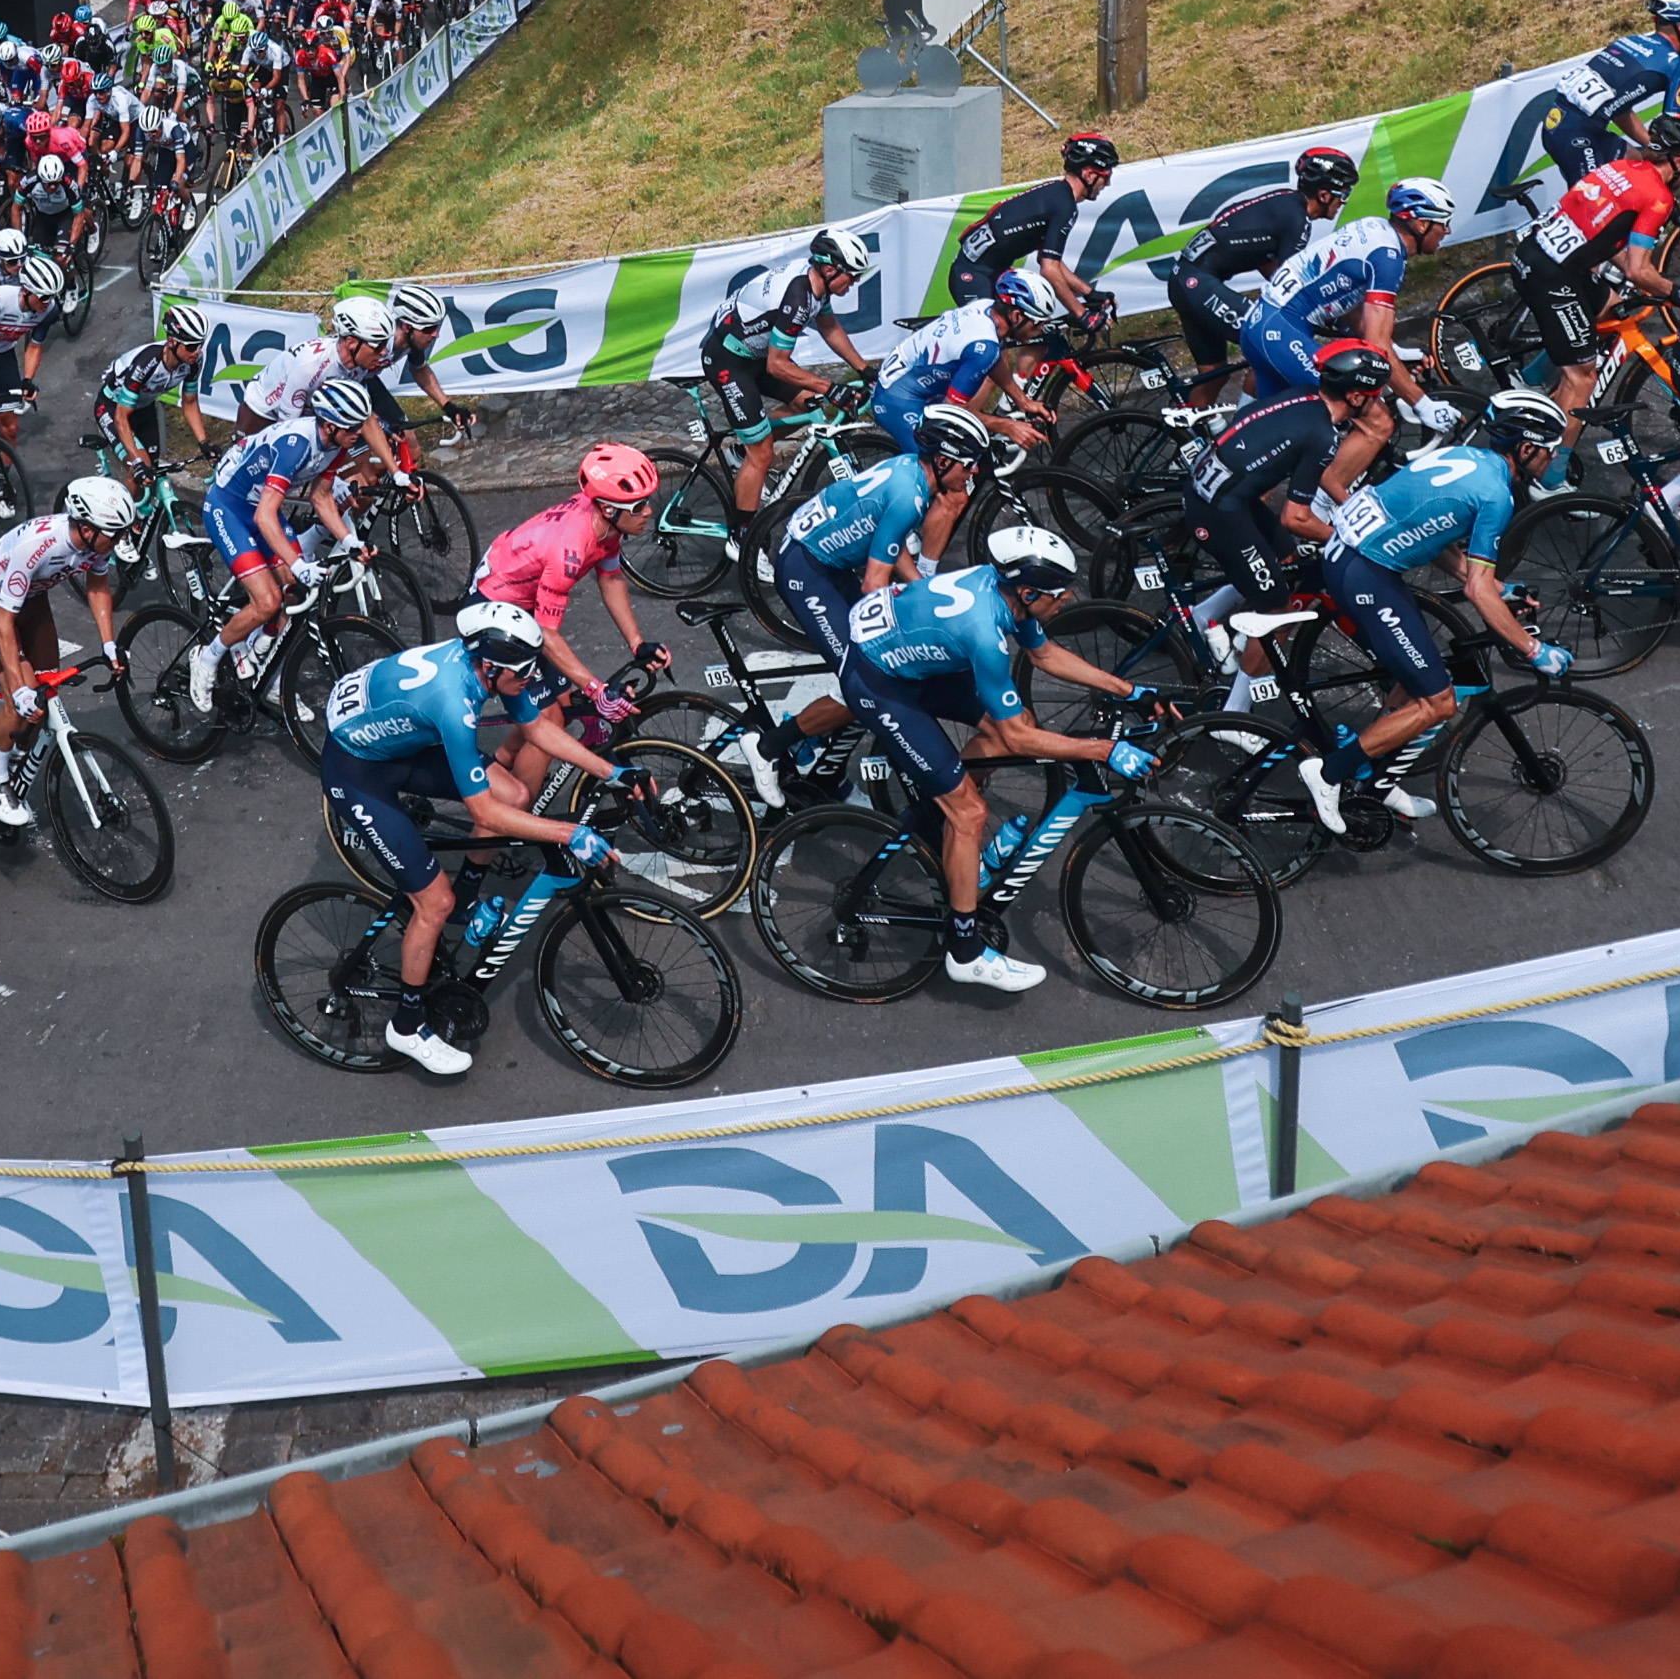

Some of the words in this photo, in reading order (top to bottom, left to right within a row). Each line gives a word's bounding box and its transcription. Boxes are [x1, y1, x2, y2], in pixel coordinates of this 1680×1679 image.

[1577, 77, 1607, 102] 57
[1542, 219, 1580, 256] 126
[1272, 267, 1299, 297] 04
[882, 353, 908, 379] 07
[1289, 339, 1321, 378] Groupa
[1454, 343, 1476, 368] 126
[1588, 337, 1628, 410] RIDA
[1182, 444, 1198, 463] 10
[212, 508, 239, 557] Groupama
[817, 512, 877, 554] movistar
[1342, 497, 1380, 539] 191
[1382, 510, 1459, 558] movistar
[1241, 544, 1275, 592] INEOS
[859, 592, 891, 636] 197
[880, 642, 951, 670] movistar
[1392, 626, 1430, 670] movistar
[335, 673, 362, 717] 194
[706, 670, 732, 687] 195
[1251, 684, 1277, 701] 191
[348, 716, 419, 748] movistar
[892, 731, 933, 773] movistar
[531, 761, 574, 817] annondale
[862, 761, 888, 779] 197
[364, 826, 405, 871] movistar
[992, 814, 1080, 903] CANYON
[474, 897, 549, 980] CANYON
